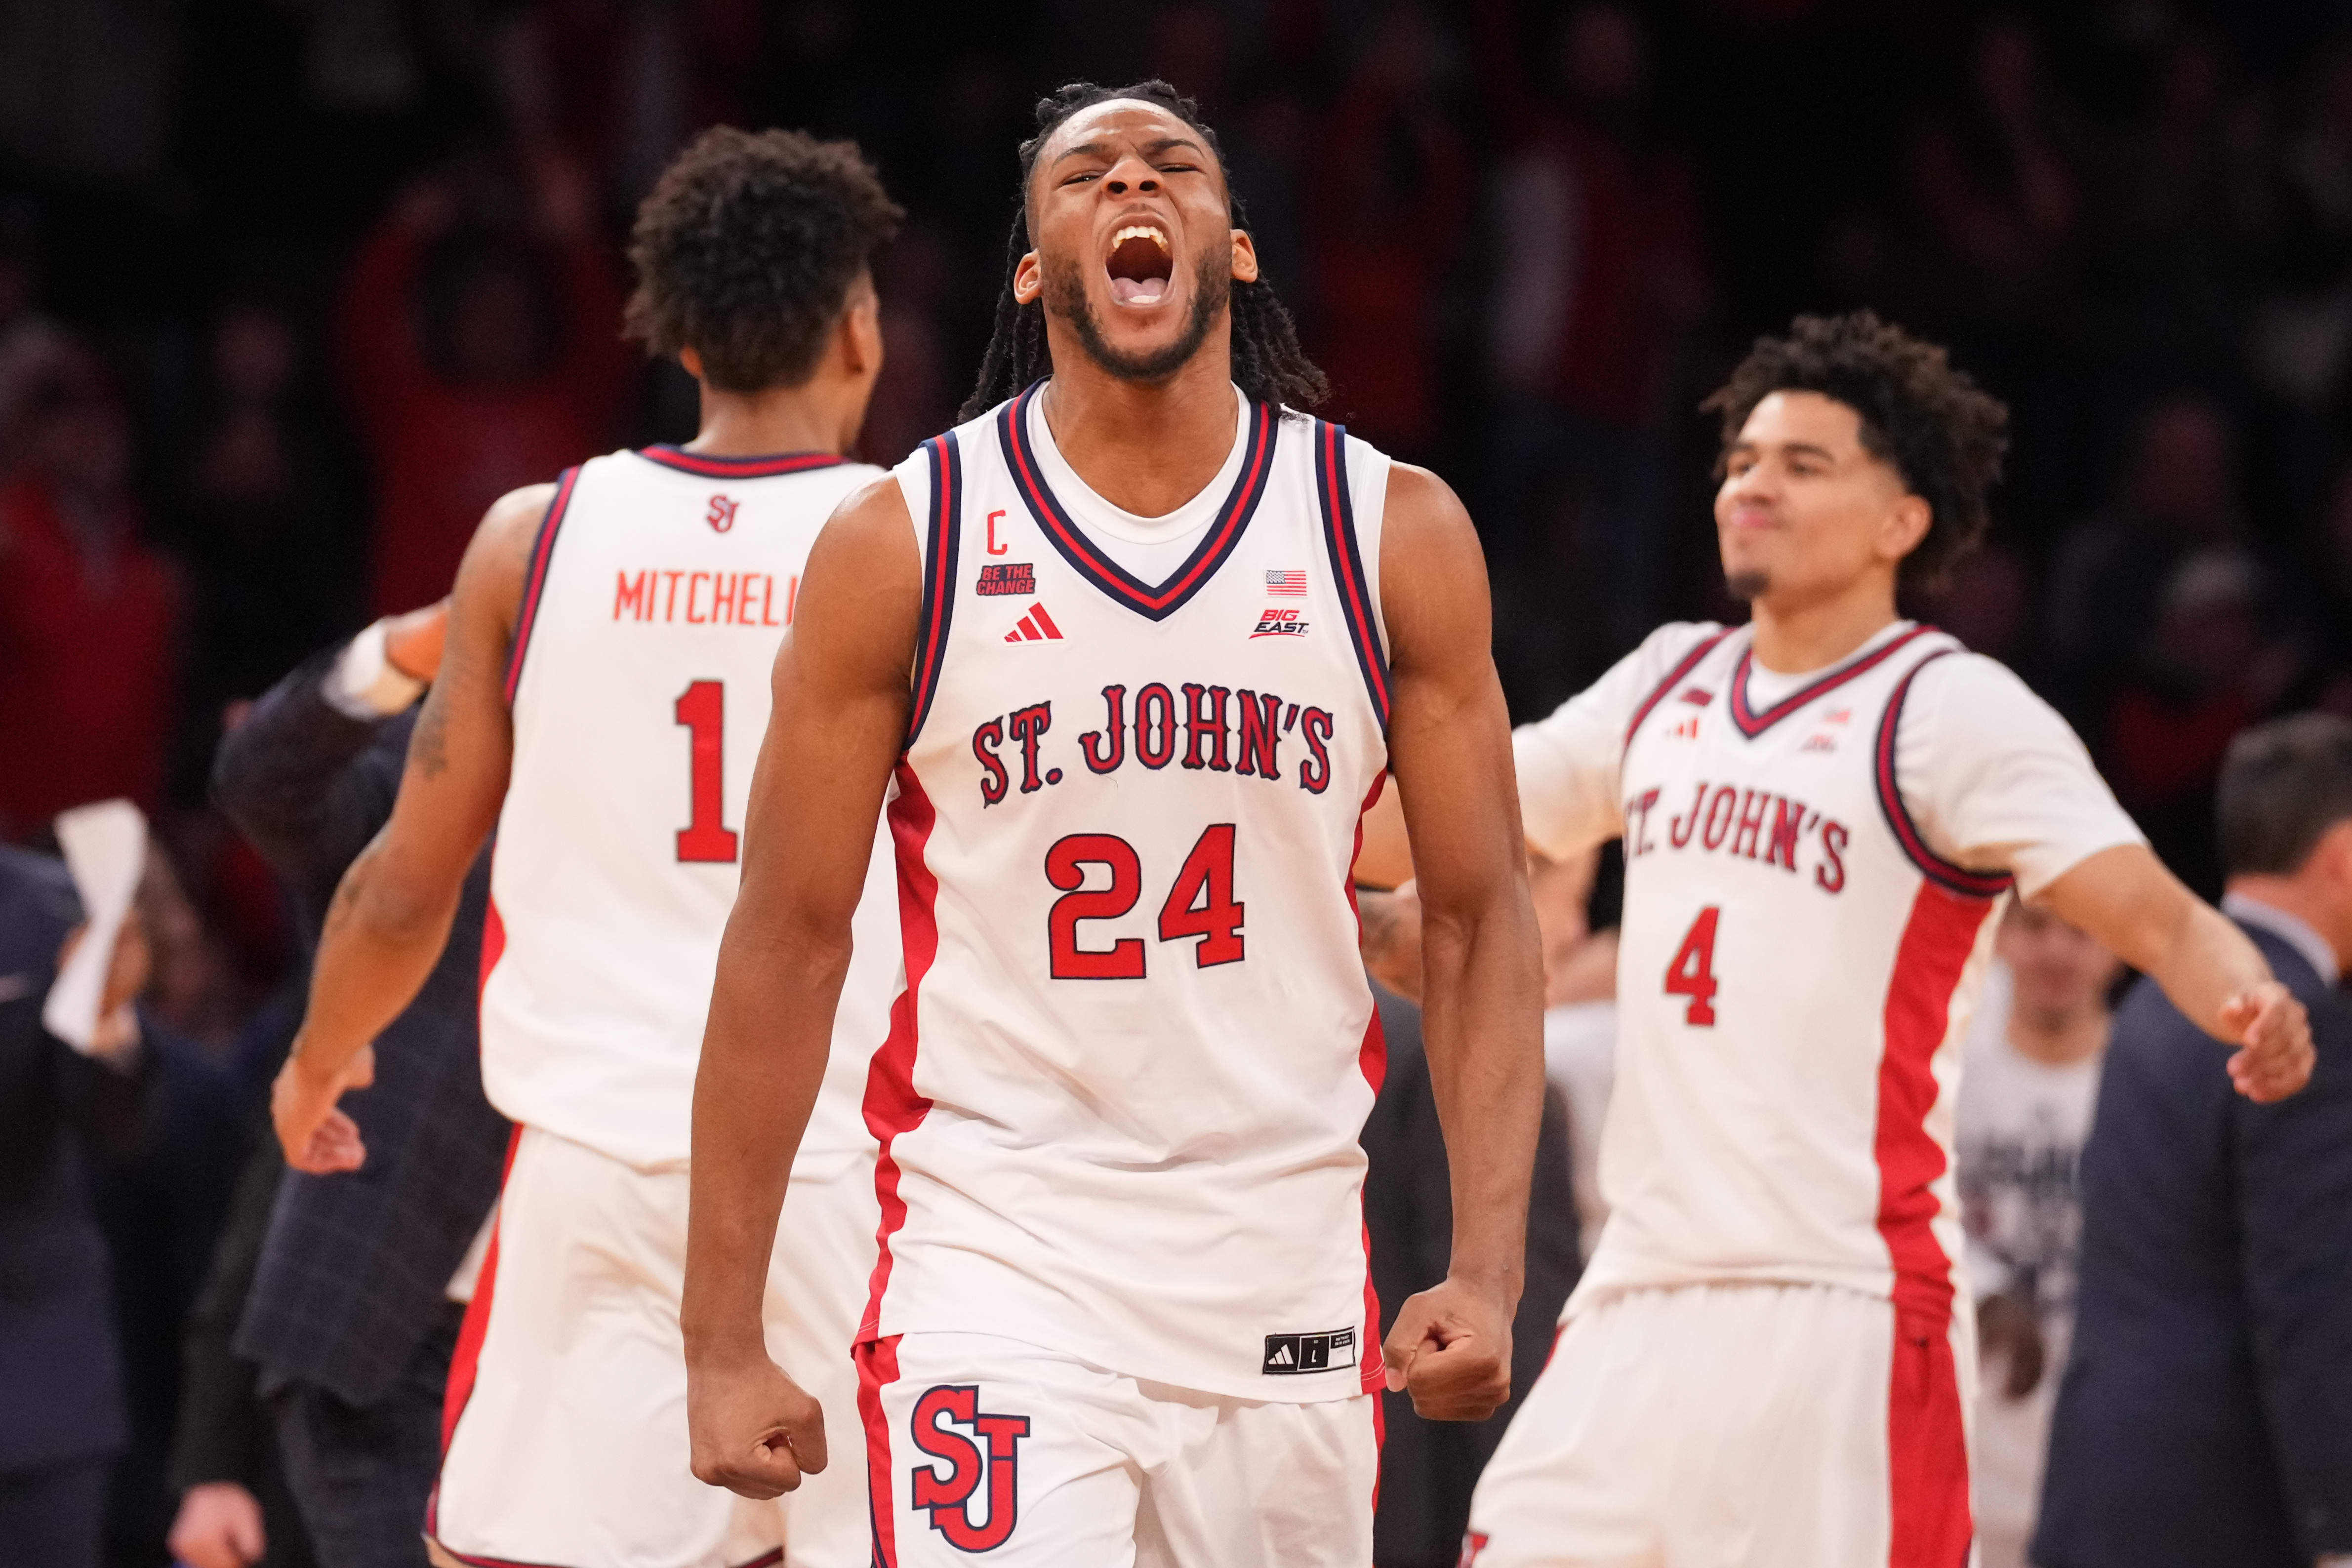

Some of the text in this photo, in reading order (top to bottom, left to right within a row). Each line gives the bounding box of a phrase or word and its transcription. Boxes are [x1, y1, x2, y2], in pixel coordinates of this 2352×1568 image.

[987, 509, 1008, 556] C
[977, 579, 1035, 595] CHANGE
[982, 564, 1032, 580] BE THE
[1254, 621, 1309, 634] EAST
[1260, 609, 1300, 621] BIG
[972, 682, 1334, 810] ST. JOHN'S
[675, 679, 739, 863] 1
[1669, 782, 1849, 895] JOHN'S
[1045, 823, 1245, 979] 24
[1663, 905, 1720, 1027] 4
[1311, 1349, 1317, 1363] L
